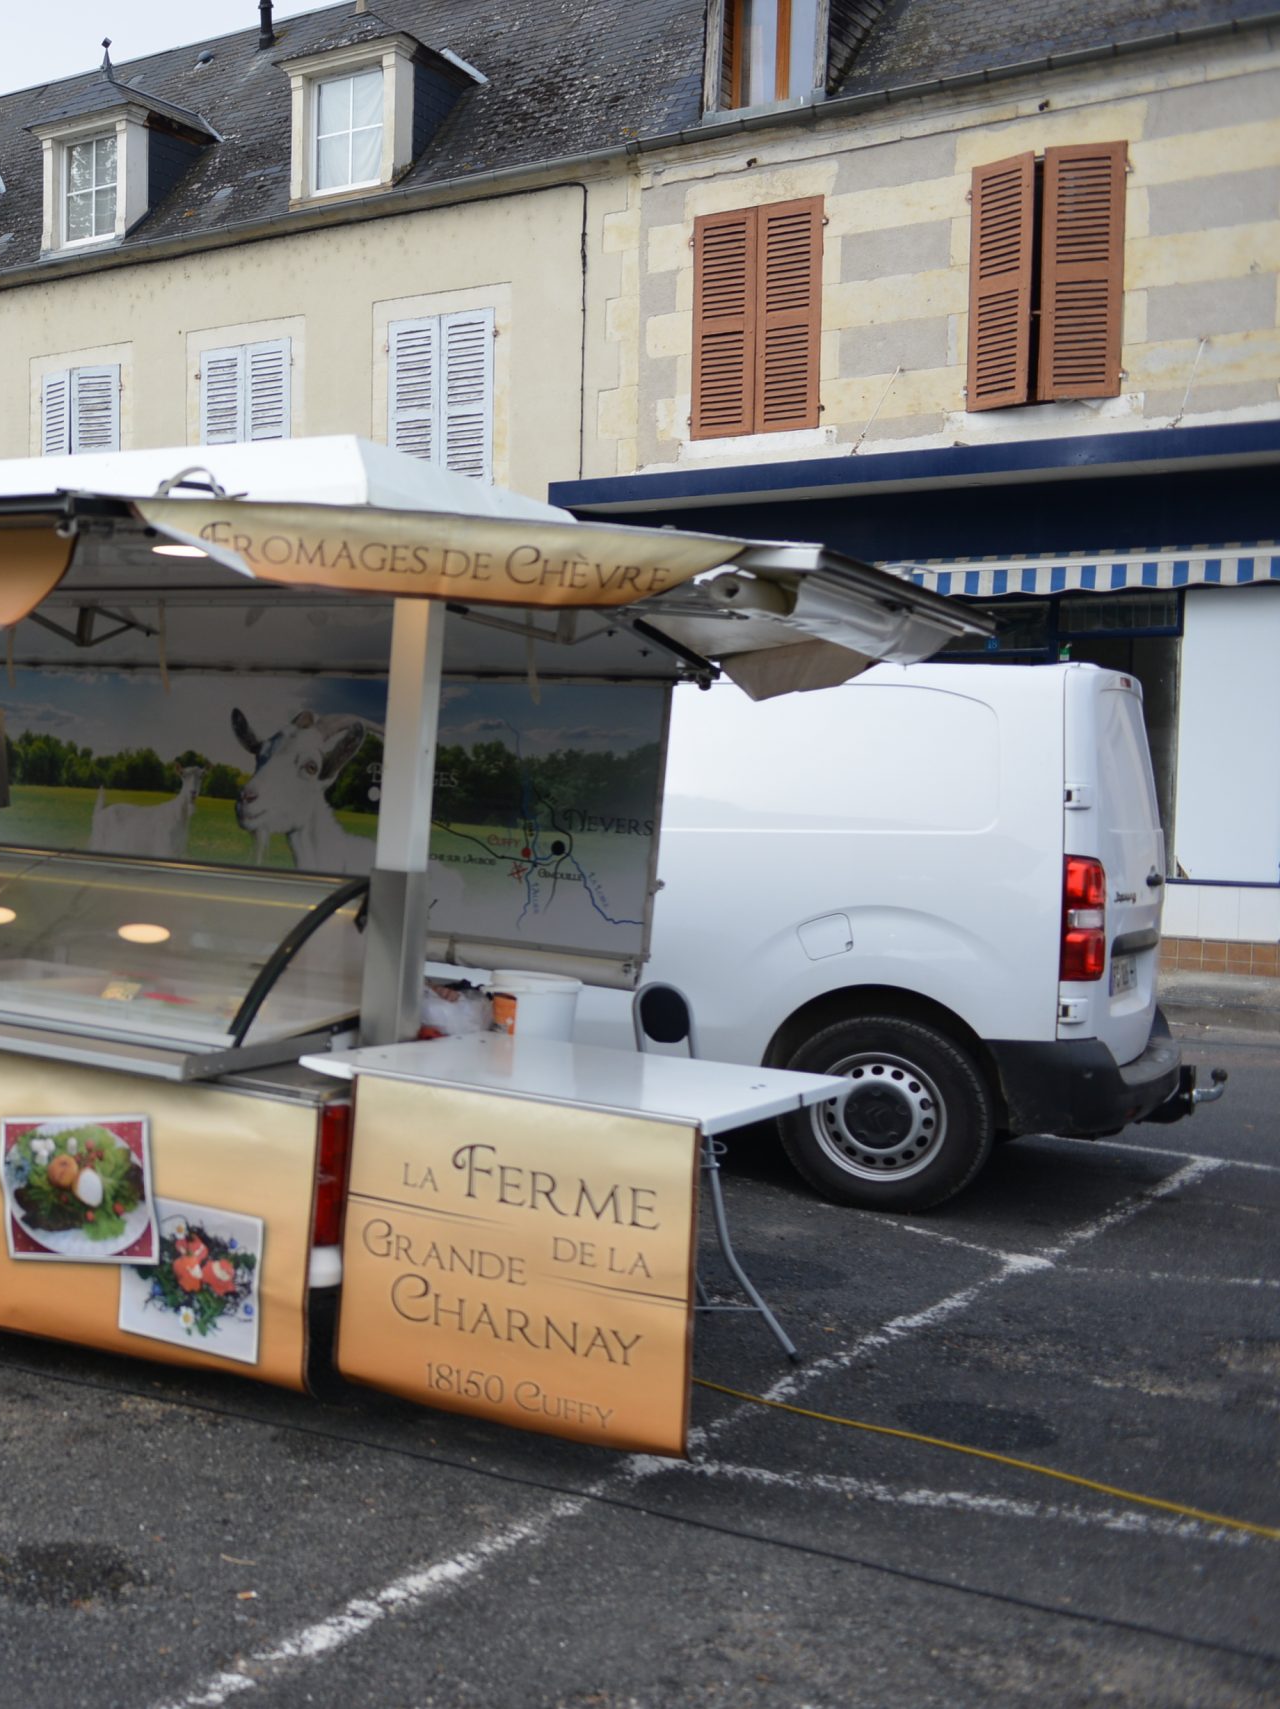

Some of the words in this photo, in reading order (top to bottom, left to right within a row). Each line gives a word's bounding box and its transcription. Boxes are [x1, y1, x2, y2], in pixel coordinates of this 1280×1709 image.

[199, 520, 429, 575] FROMAGES
[440, 548, 494, 582] DE
[505, 545, 671, 592] CHÈVRE
[563, 809, 654, 837] NEVERS
[401, 1162, 440, 1193] LA
[451, 1143, 661, 1232] FERME
[361, 1218, 529, 1287] GRANDE
[551, 1236, 599, 1269] DE
[608, 1246, 654, 1279] LA
[390, 1273, 644, 1367] CHARNAY
[426, 1361, 505, 1405] 18150
[514, 1380, 614, 1430] CUFFY
